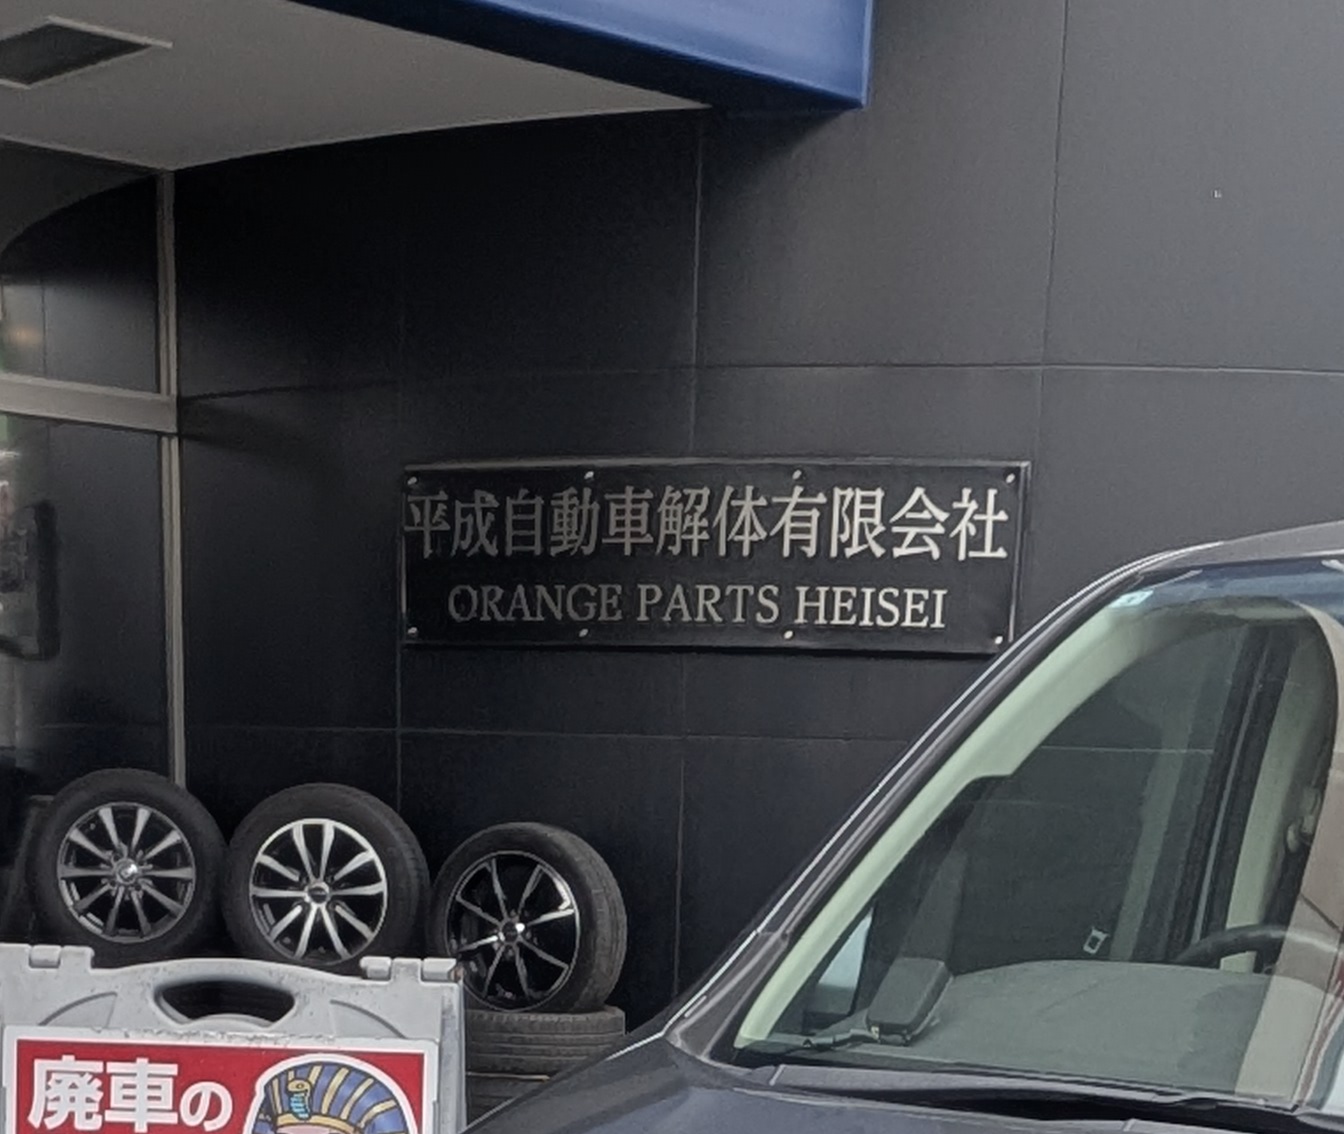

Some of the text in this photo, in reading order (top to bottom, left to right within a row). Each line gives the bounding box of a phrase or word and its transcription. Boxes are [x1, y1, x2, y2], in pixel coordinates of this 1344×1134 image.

[404, 485, 1009, 561] 平成自動車解体有限会社
[448, 583, 948, 629] ORANGE PARTS HEISEI
[27, 1054, 233, 1133] 廃車の
